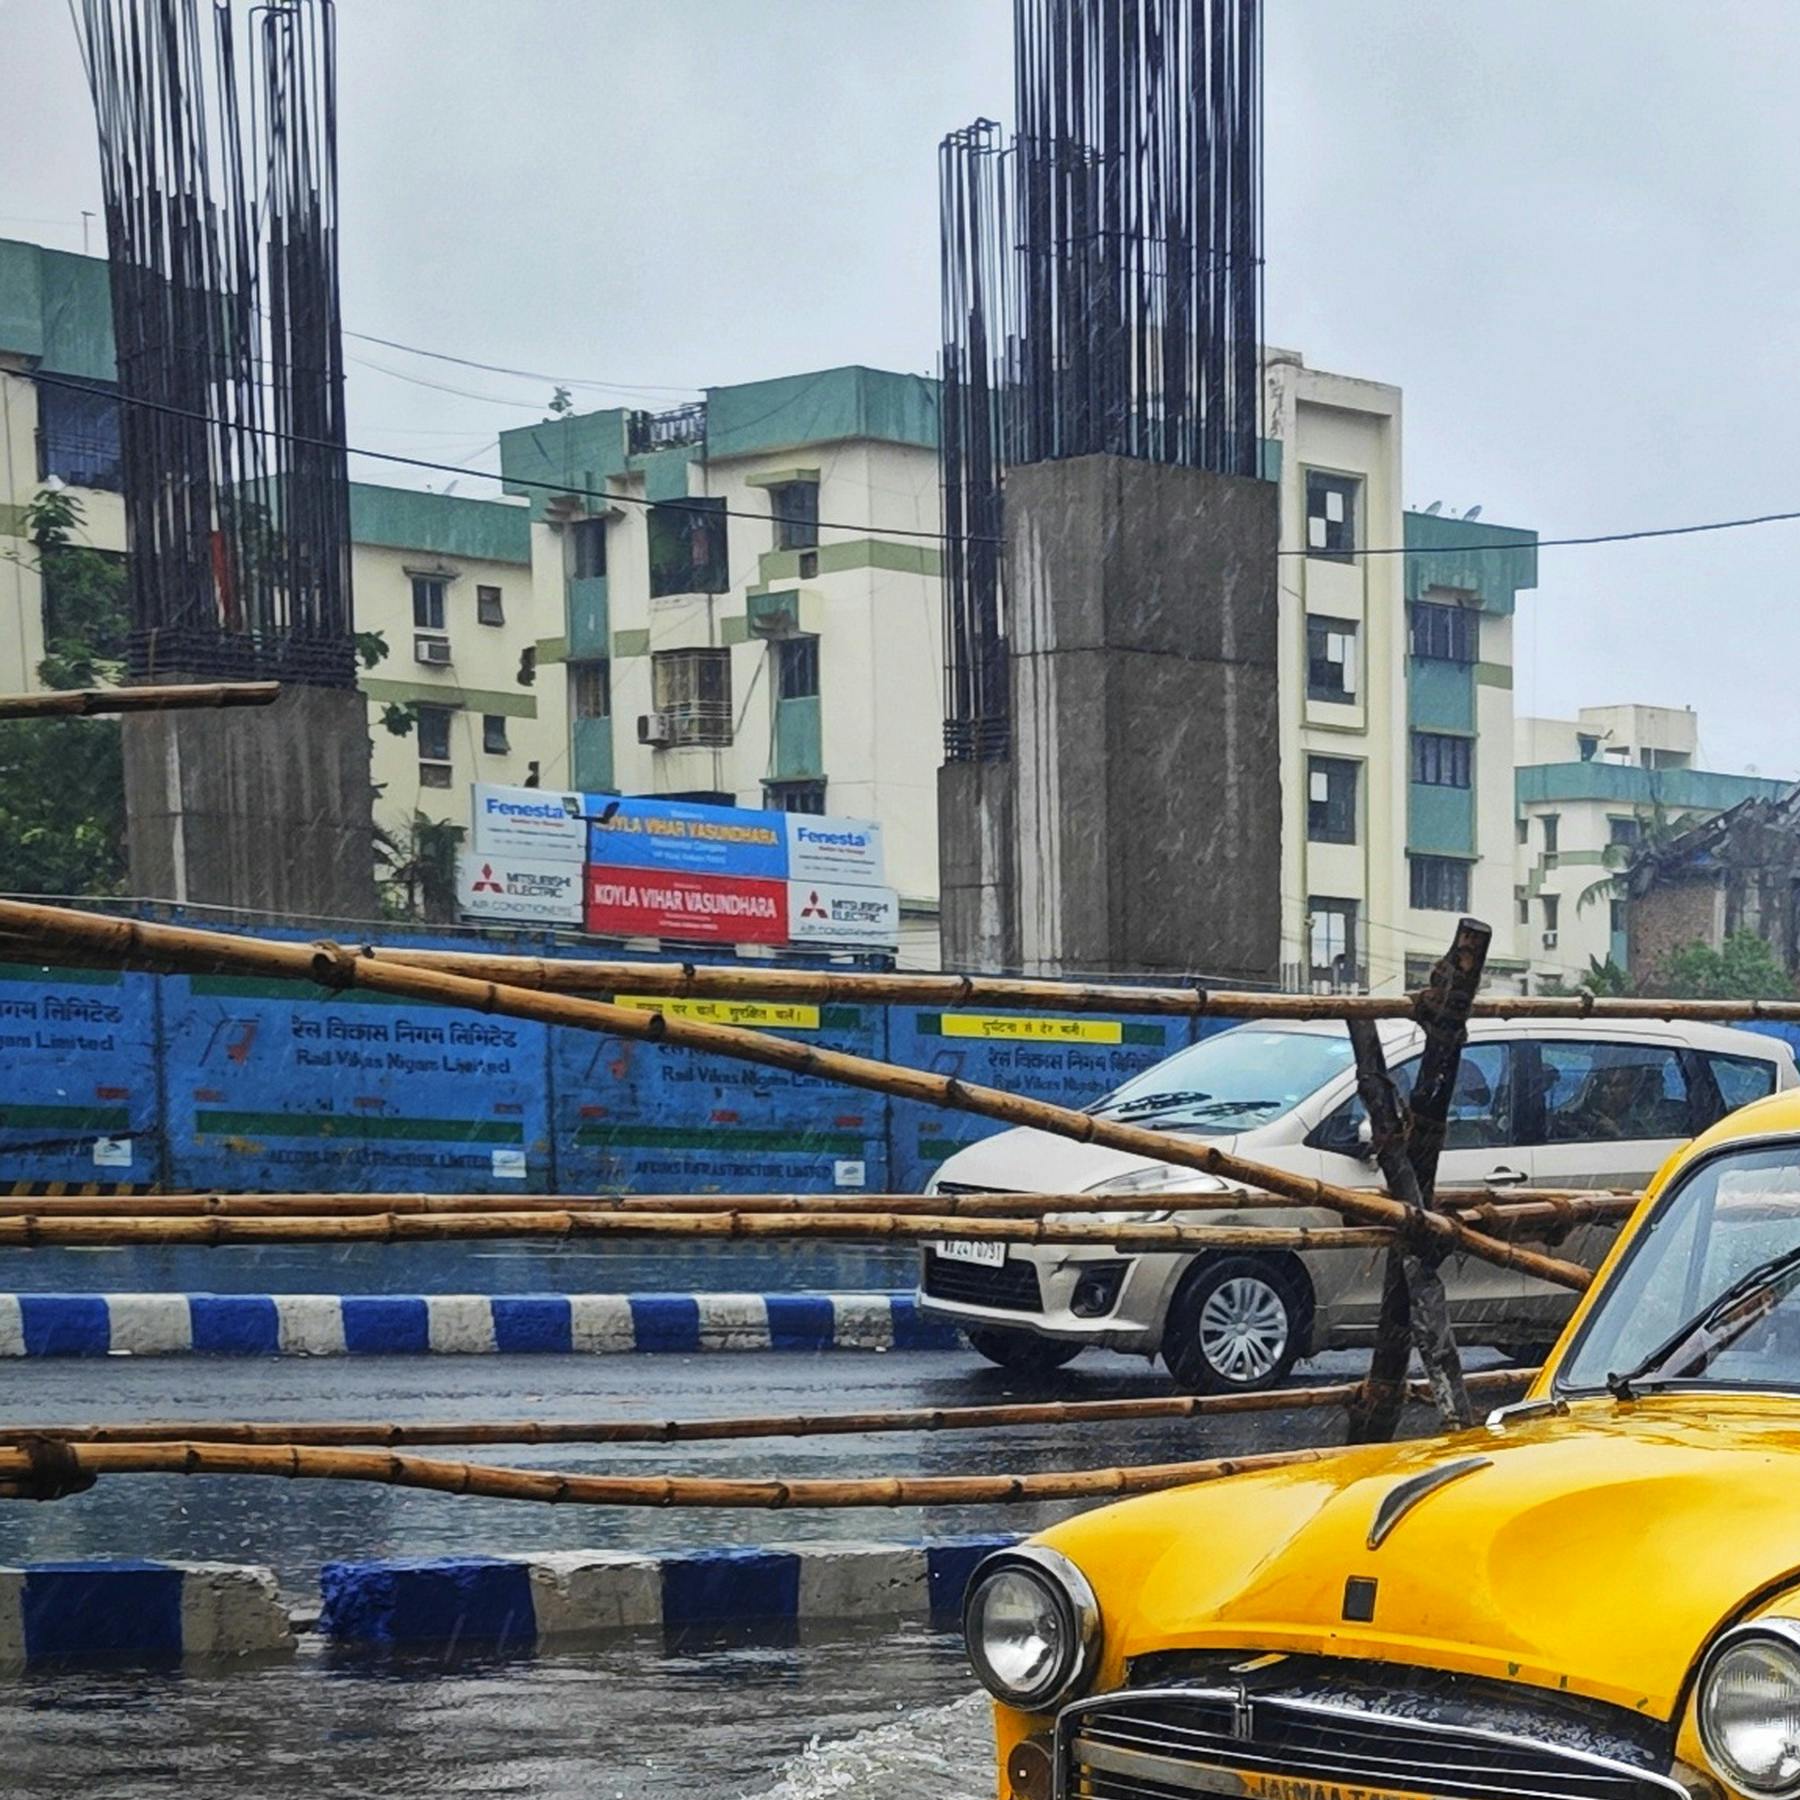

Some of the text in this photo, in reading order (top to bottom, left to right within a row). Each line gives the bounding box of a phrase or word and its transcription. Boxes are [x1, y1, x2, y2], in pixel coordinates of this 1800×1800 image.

[486, 798, 565, 820] Fenesta
[797, 827, 866, 847] Fenesta
[594, 884, 640, 908] KOYLA
[640, 888, 684, 911] VIHAR
[685, 891, 777, 918] VASUNDHARA
[291, 1015, 518, 1048] रेल विकास निगम लिमिटेड
